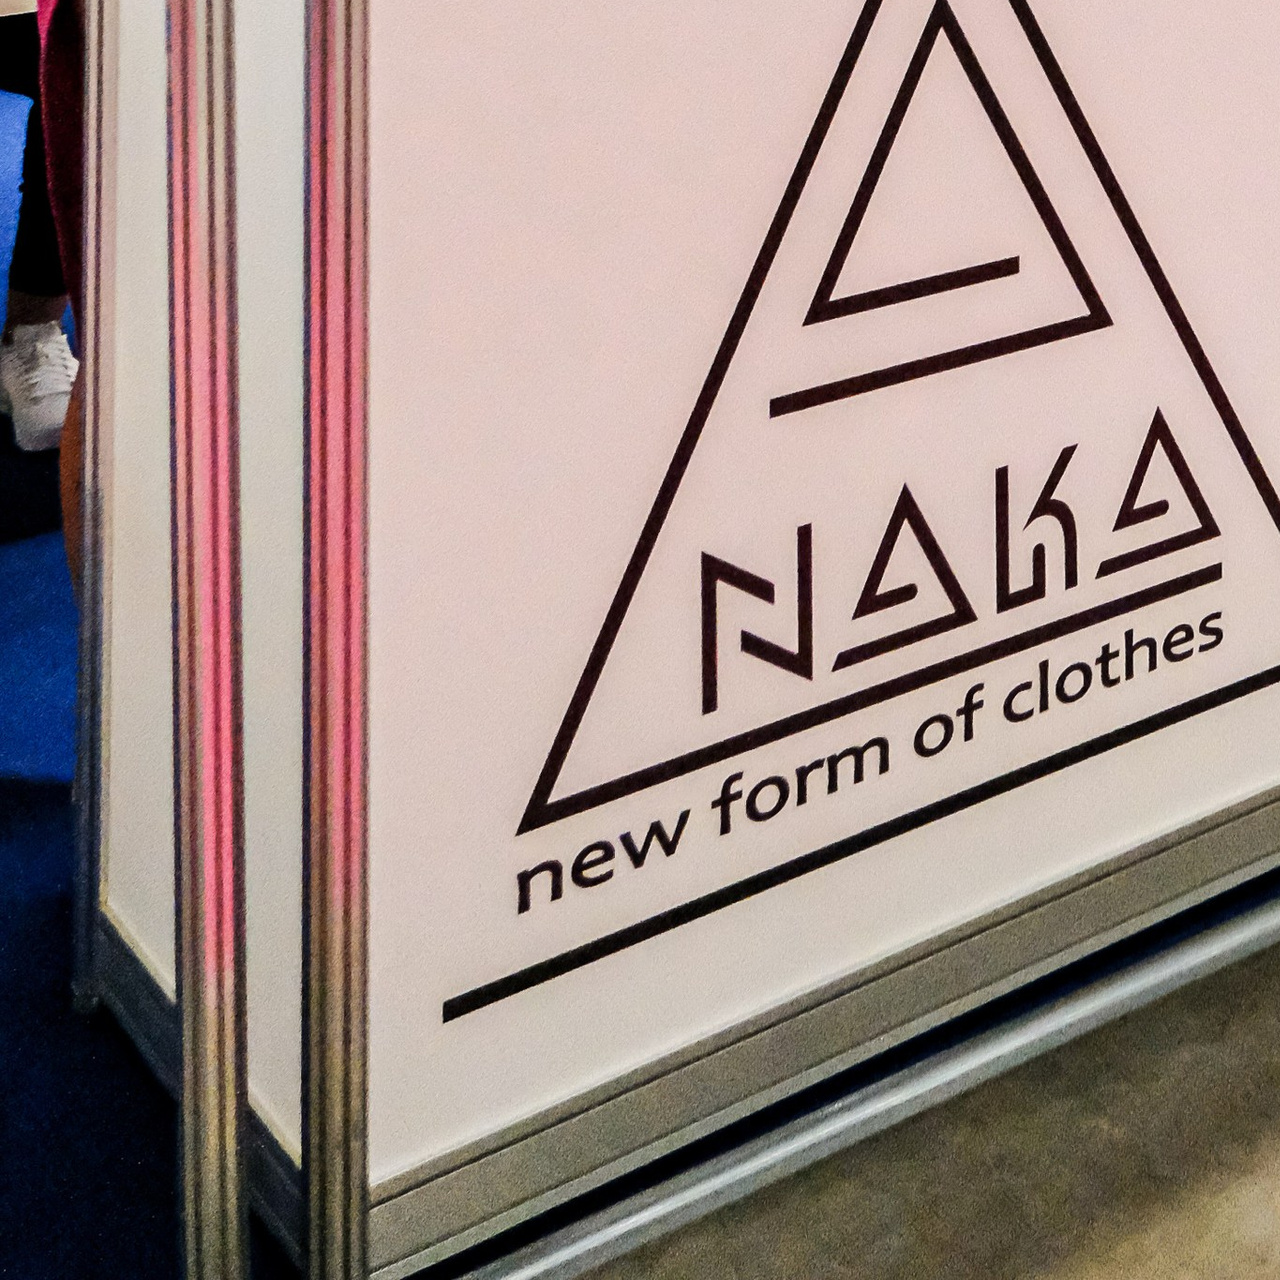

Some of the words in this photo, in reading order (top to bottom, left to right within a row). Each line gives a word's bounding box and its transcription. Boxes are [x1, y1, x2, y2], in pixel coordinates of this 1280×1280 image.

[701, 406, 1222, 715] NAKA
[516, 809, 691, 914] new
[712, 734, 890, 838] form
[913, 683, 986, 759] of
[1003, 611, 1224, 723] clothes
